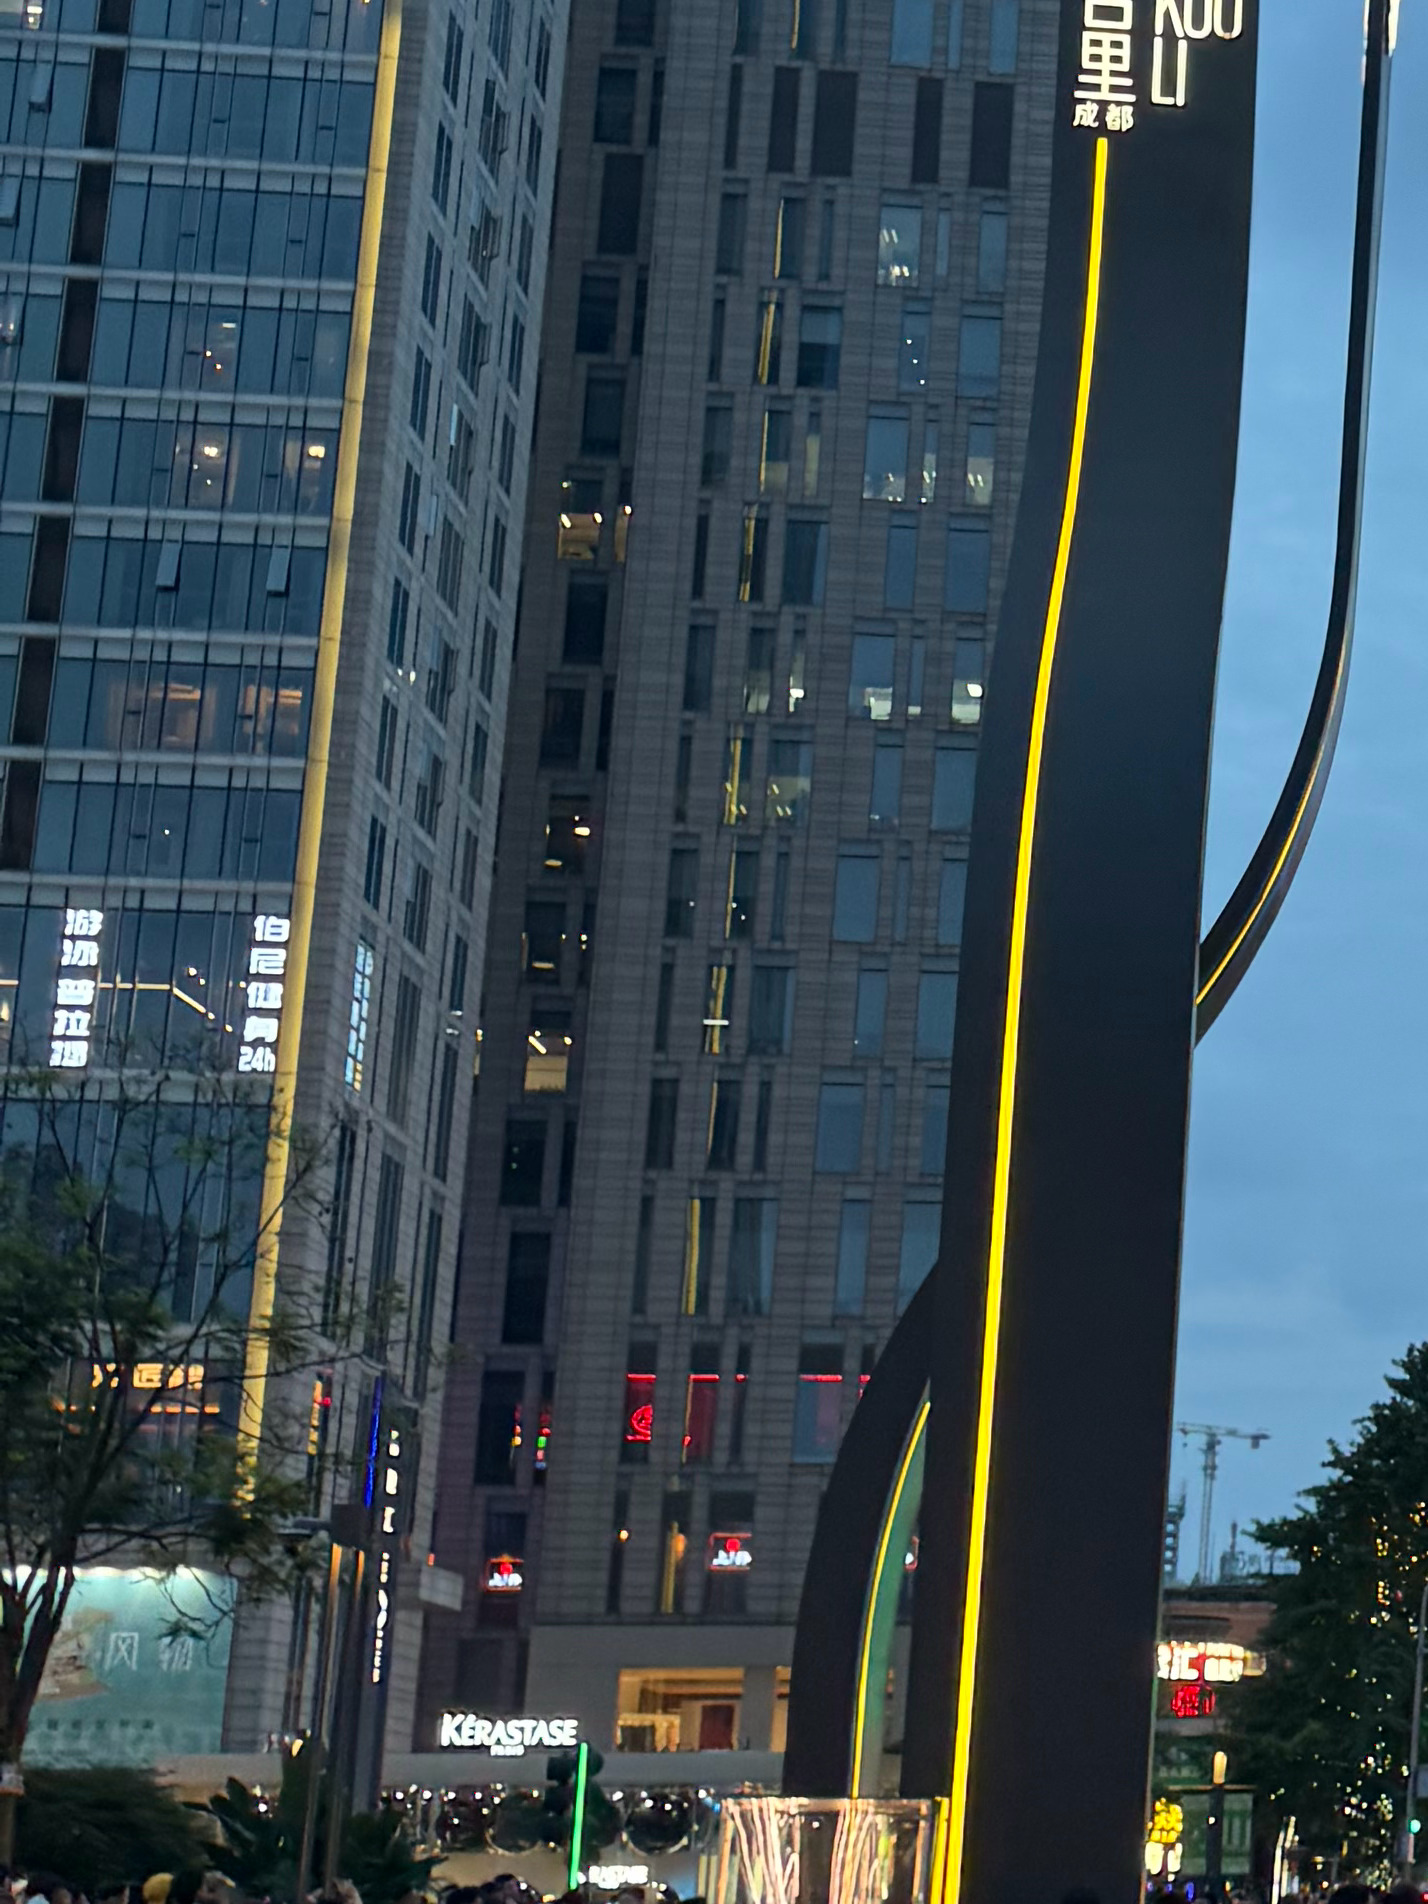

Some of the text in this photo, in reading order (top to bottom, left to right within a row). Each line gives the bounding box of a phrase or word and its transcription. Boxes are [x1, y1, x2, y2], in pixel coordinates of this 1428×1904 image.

[1151, 36, 1188, 107] LI
[1072, 102, 1134, 132] 成都
[441, 1713, 578, 1746] KÉRASTASE
